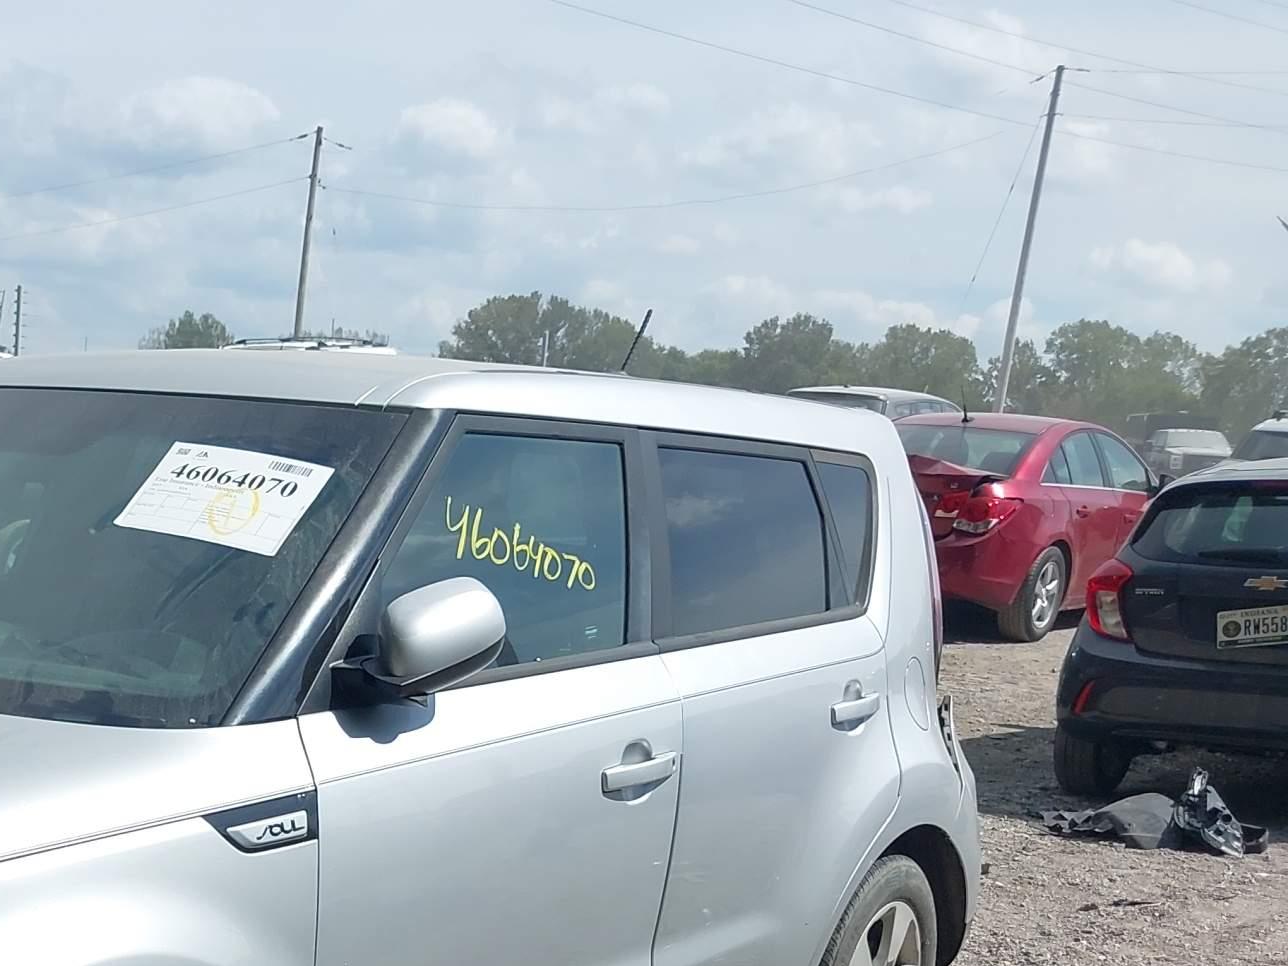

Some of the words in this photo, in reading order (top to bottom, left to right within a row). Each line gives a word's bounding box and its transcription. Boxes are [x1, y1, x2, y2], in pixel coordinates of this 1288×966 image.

[170, 463, 299, 498] 46064070
[445, 495, 596, 590] 46064070
[1244, 615, 1288, 636] RW558
[255, 819, 306, 840] SOUL
